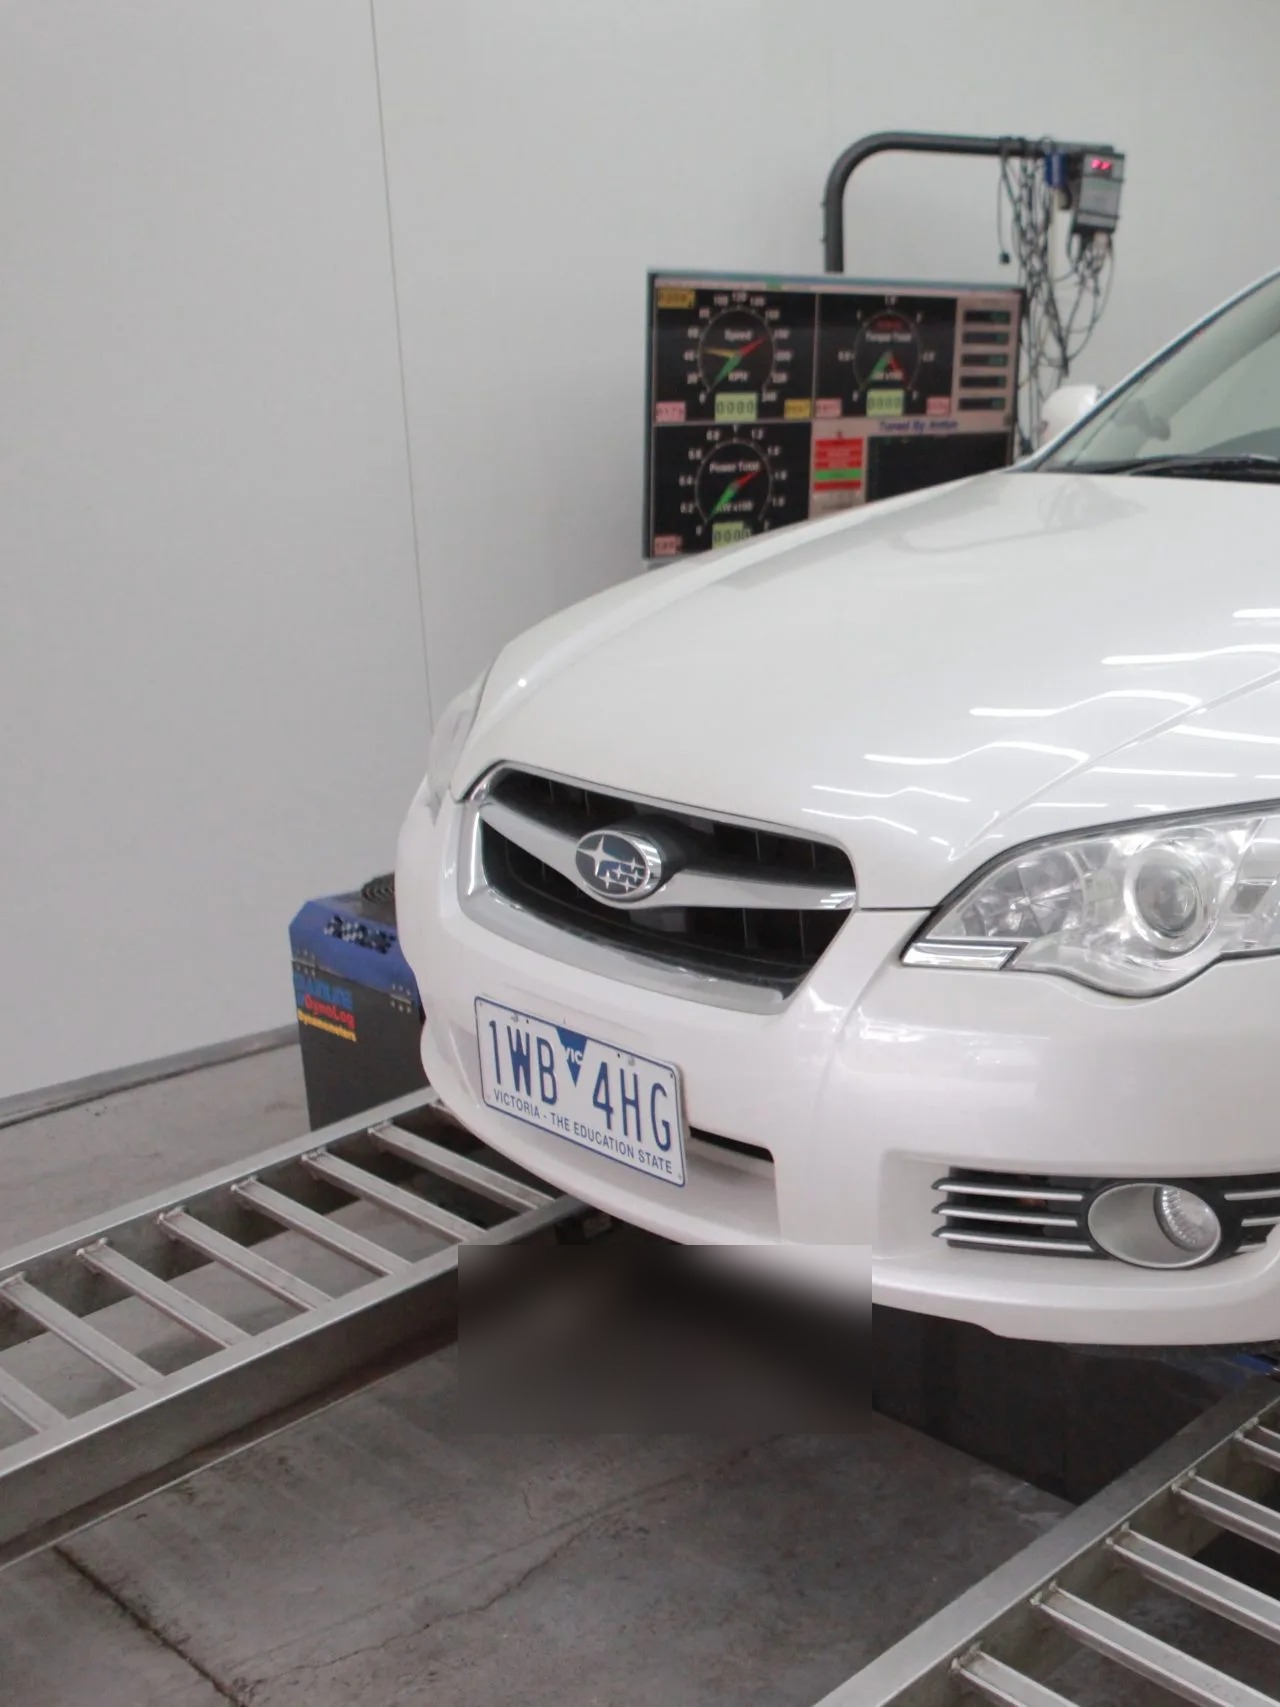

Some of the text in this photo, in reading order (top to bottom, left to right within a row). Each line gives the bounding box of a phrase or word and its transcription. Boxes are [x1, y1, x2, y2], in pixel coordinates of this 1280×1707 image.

[489, 1019, 672, 1152] 1WB 4HG
[564, 1046, 584, 1063] VIC
[493, 1087, 541, 1120] VICTORIA
[551, 1114, 570, 1133] THE
[573, 1121, 635, 1159] EDUCATION
[638, 1148, 673, 1175] STATE
